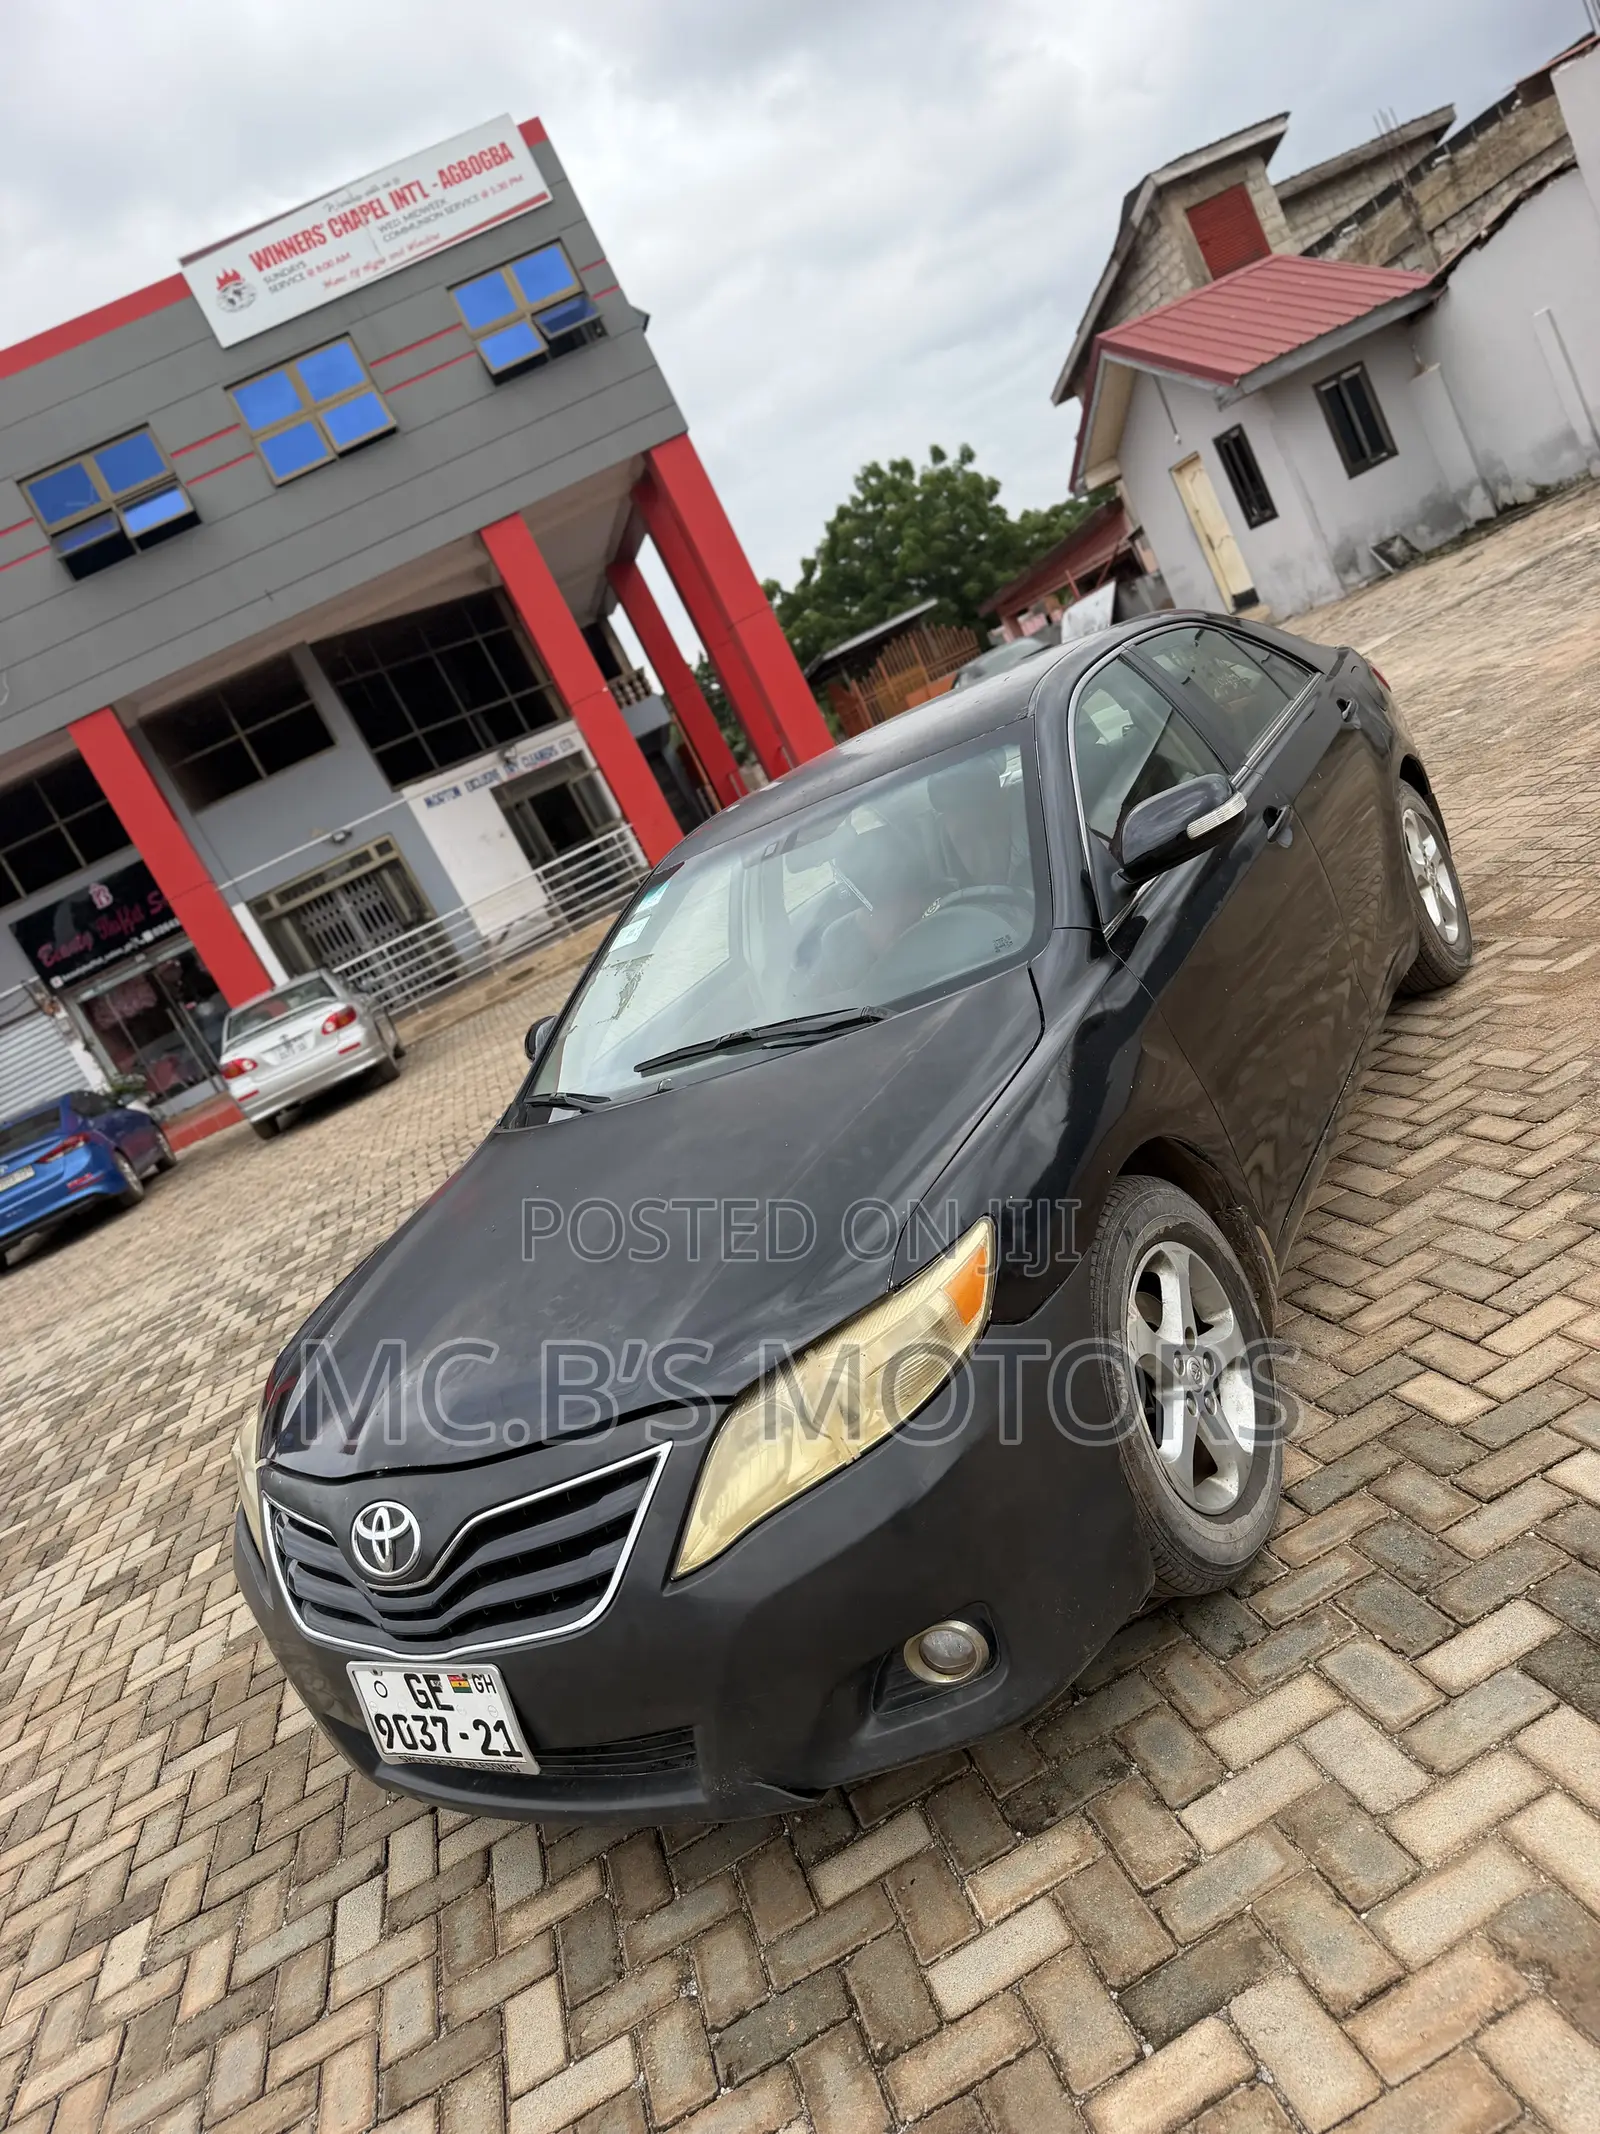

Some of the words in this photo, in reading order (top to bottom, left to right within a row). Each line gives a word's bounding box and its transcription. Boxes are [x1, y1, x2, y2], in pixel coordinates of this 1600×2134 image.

[326, 196, 390, 238] CHAPEL
[436, 142, 514, 188] AGBOGBA
[382, 210, 445, 241] COMMUNION
[444, 193, 480, 215] SERVICE
[402, 197, 447, 221] MIDWEEK
[263, 260, 305, 284] SUNDAYS
[268, 272, 305, 294] SERVICE
[404, 1673, 454, 1711] GE
[472, 1674, 497, 1694] GH
[466, 1761, 522, 1774] BLESSING
